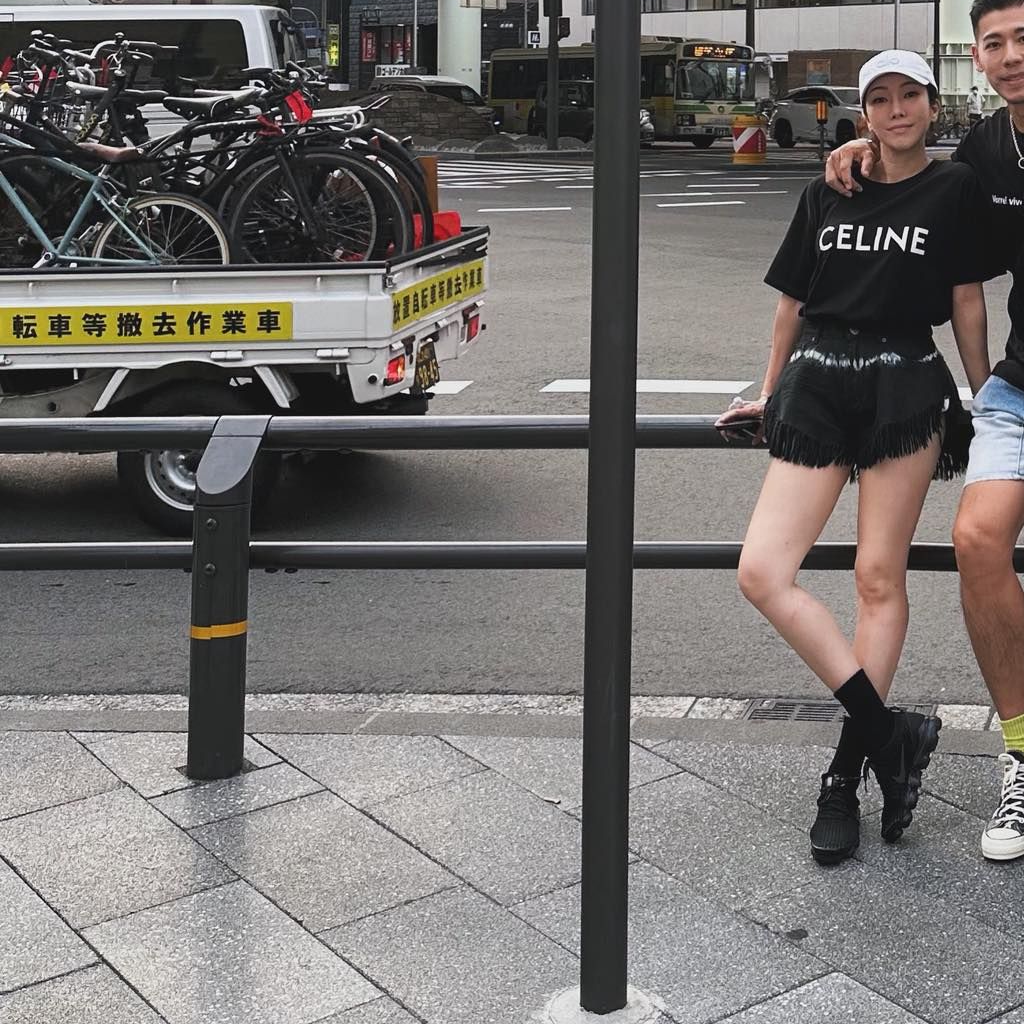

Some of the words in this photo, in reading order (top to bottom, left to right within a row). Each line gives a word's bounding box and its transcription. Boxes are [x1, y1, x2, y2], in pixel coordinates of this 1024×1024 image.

[818, 223, 930, 256] CELINE
[11, 309, 282, 339] 転車等撤去作業車
